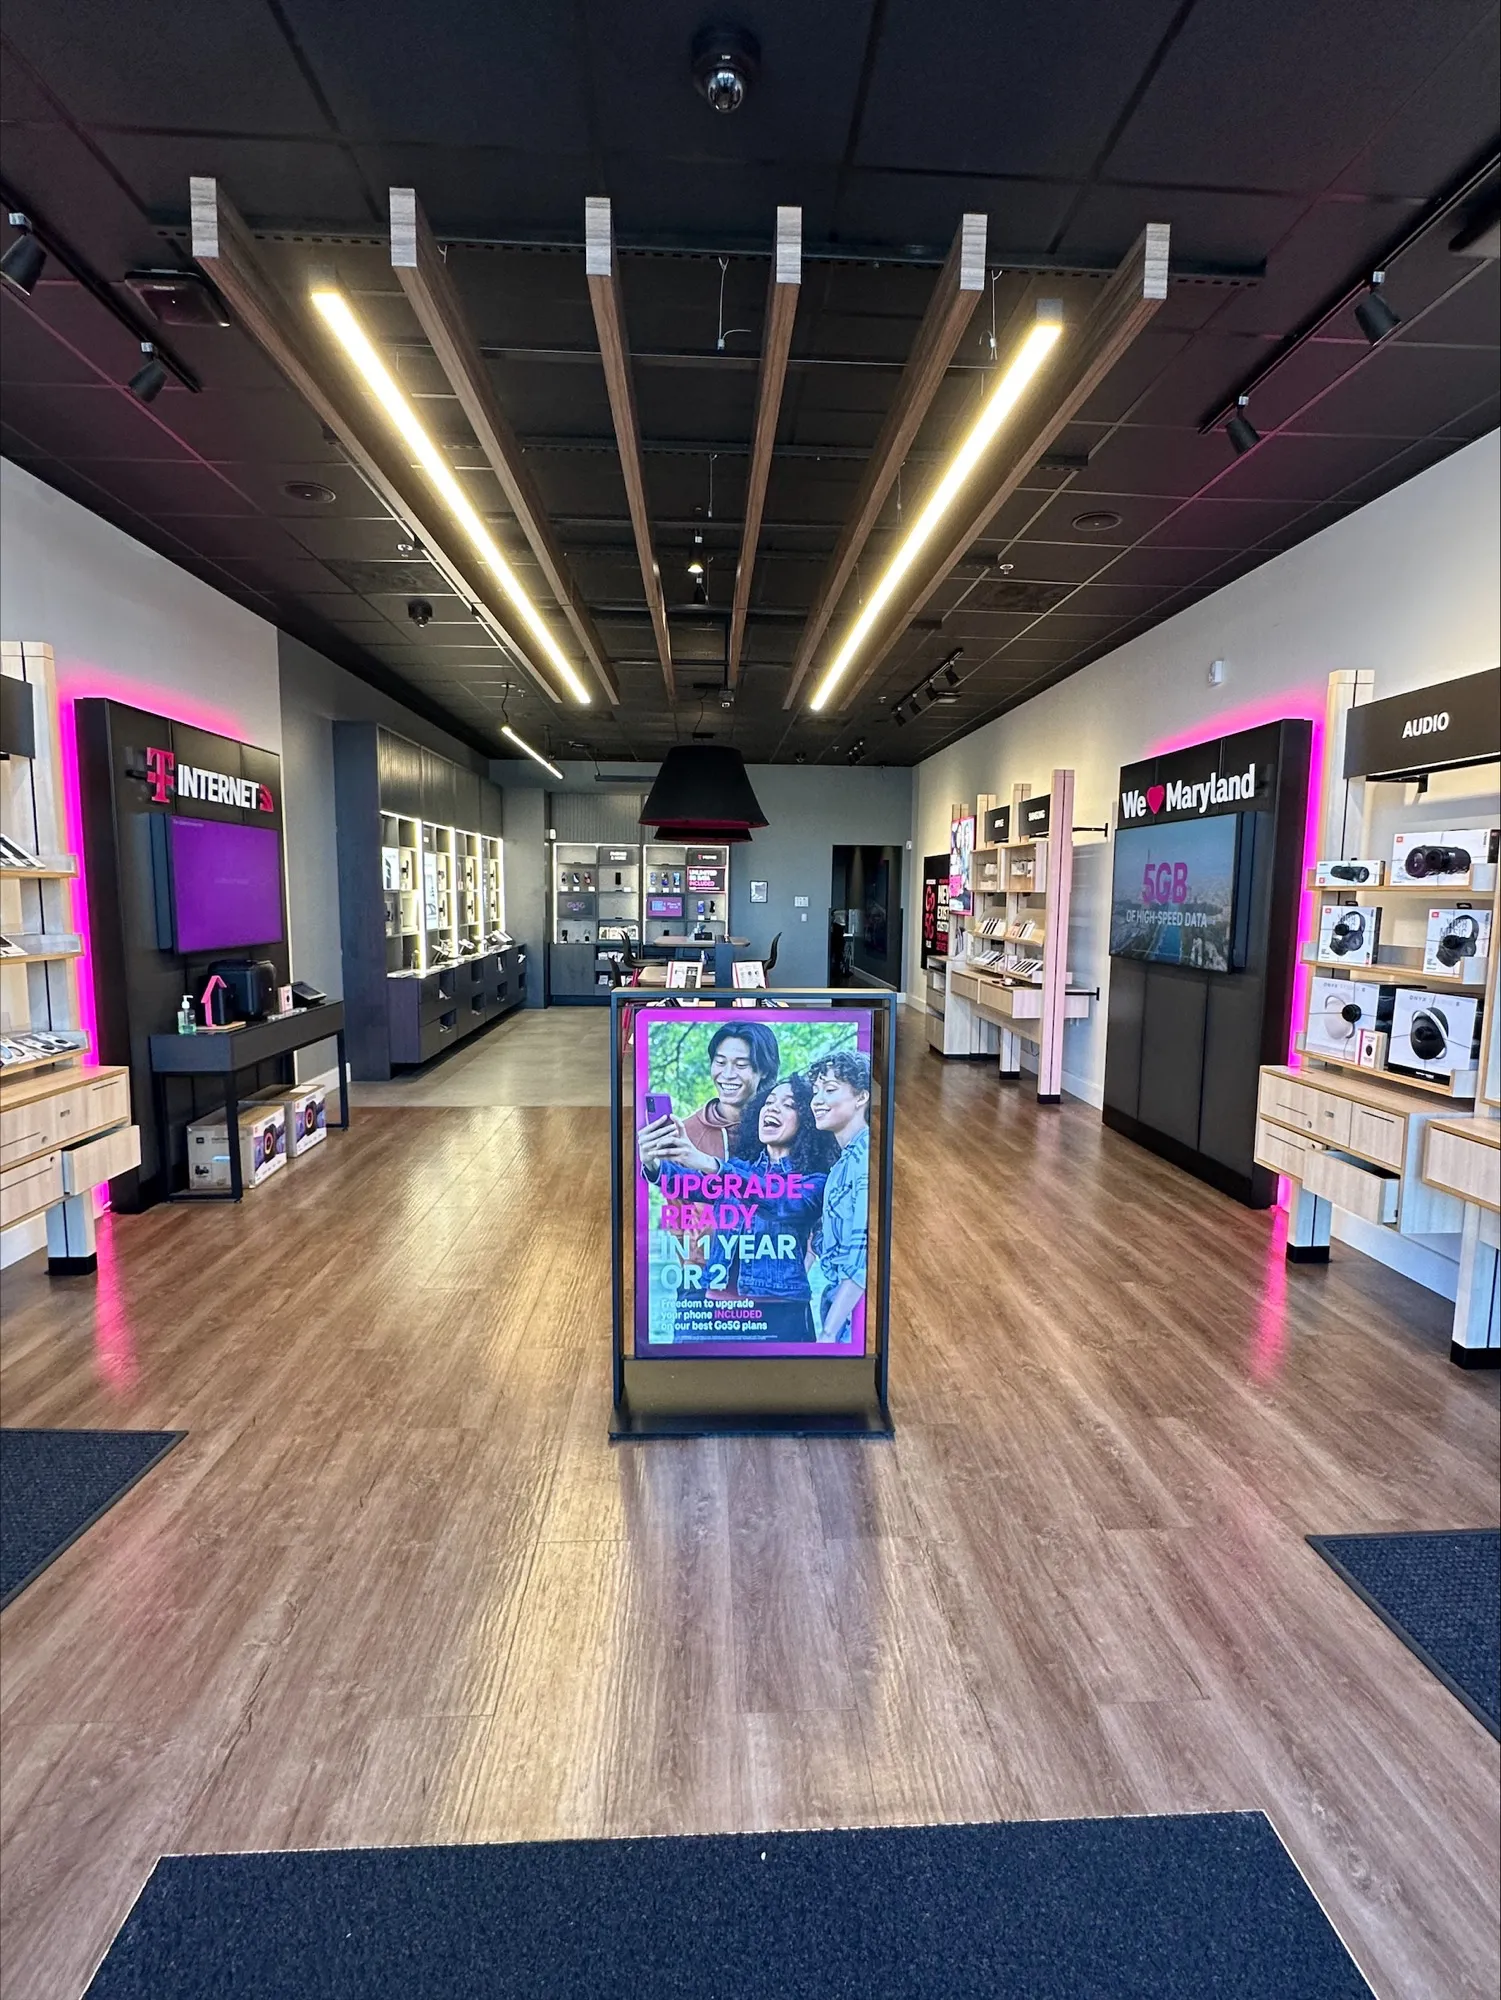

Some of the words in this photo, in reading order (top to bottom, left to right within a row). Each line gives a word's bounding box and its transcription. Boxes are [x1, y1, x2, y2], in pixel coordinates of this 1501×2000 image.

[1402, 711, 1450, 739] AUDIO
[177, 763, 259, 810] INTERNET
[1122, 789, 1147, 819] We
[1165, 763, 1256, 814] Maryland
[1142, 862, 1189, 905] 5GB
[1126, 909, 1137, 923] OF
[1137, 909, 1183, 926] HIGH-SPEED
[1185, 911, 1208, 928] DATA
[660, 1173, 815, 1199] UPGRADE-
[660, 1204, 759, 1230] READY
[660, 1234, 690, 1260] IN
[697, 1234, 711, 1260] 1
[717, 1234, 797, 1260] YEAR
[660, 1264, 702, 1290] OR
[709, 1263, 727, 1290] 2
[661, 1298, 702, 1308] Freedom
[703, 1299, 714, 1308] to
[715, 1298, 754, 1311] upgrade
[661, 1311, 682, 1321] your
[683, 1310, 713, 1320] phone
[714, 1310, 762, 1319] INCLUDED
[661, 1322, 674, 1331] on
[674, 1322, 690, 1330] our
[691, 1320, 713, 1330] best
[714, 1320, 741, 1331] Go5G
[741, 1320, 768, 1332] plans
